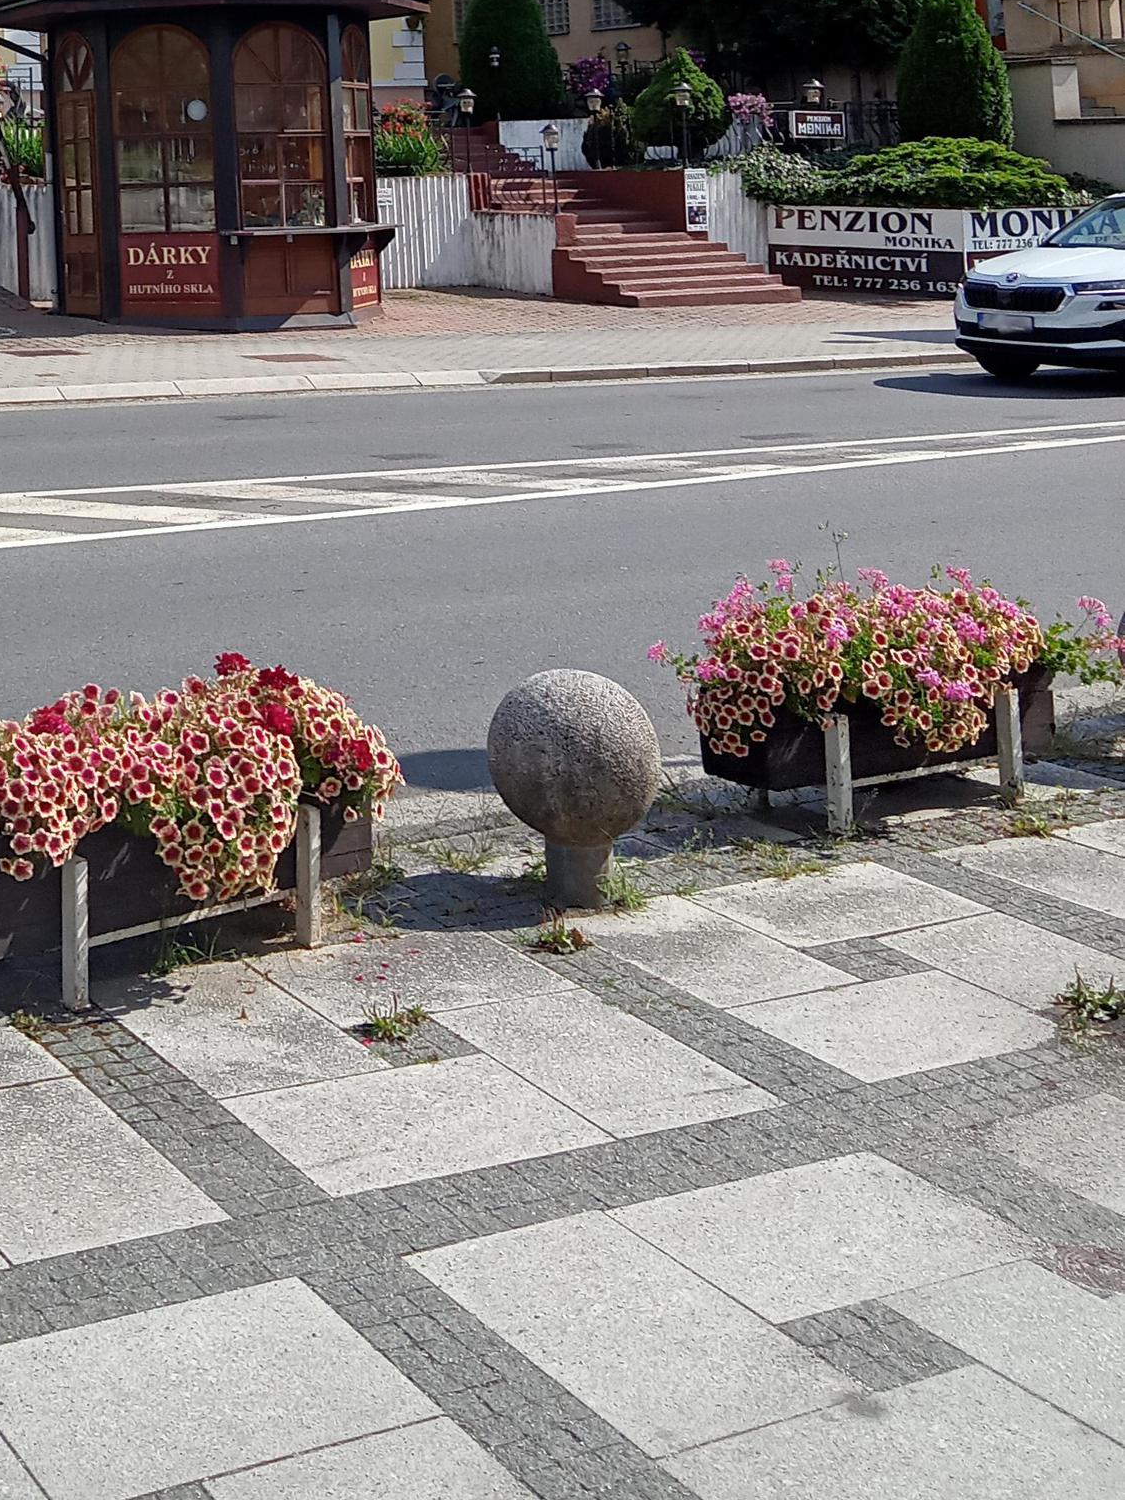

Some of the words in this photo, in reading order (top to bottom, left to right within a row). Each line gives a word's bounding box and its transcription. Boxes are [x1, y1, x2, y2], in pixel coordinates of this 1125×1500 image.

[797, 122, 842, 135] MONIKA
[774, 207, 933, 235] PENZION
[884, 235, 955, 250] MONIKA
[972, 239, 993, 250] TEL:
[996, 239, 1013, 249] 777
[1015, 238, 1033, 248] 236
[126, 242, 212, 266] DÁRKY
[775, 250, 929, 273] KADEŘNICTVÍ
[129, 282, 181, 294] HUTNÍHO
[183, 284, 214, 293] SKLA
[812, 274, 848, 287] TEL:
[853, 276, 884, 289] 777
[888, 278, 921, 291] 236
[927, 280, 957, 293] 163
